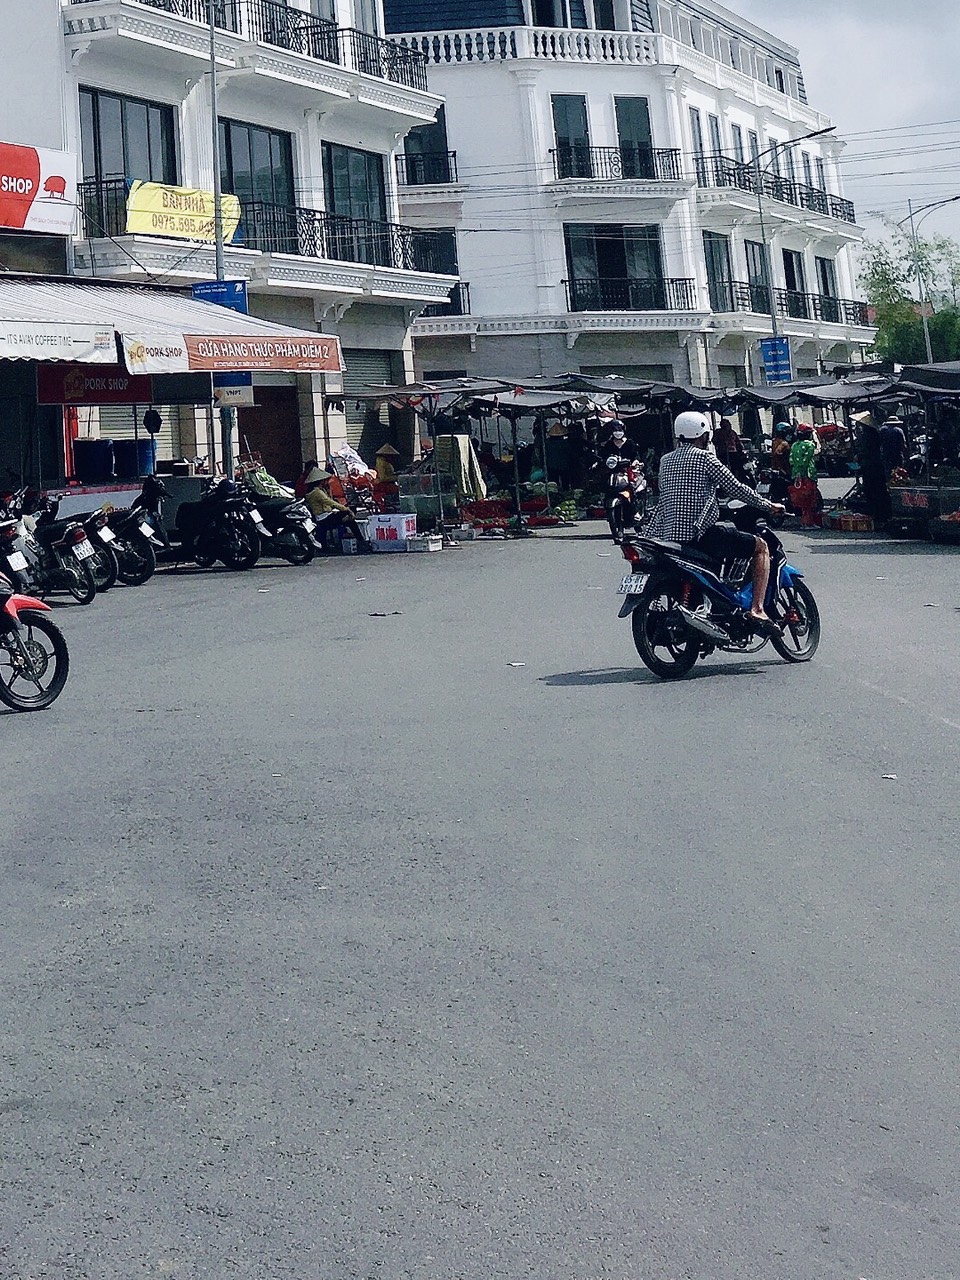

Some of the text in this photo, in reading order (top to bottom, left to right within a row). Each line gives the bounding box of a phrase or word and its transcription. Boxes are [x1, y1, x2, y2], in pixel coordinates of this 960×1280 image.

[1, 174, 34, 195] SHOP
[35, 335, 58, 346] COFFEE
[59, 335, 72, 347] TIME
[145, 347, 164, 357] PORK
[165, 347, 183, 357] SHOP
[198, 339, 221, 357] CỬA
[221, 340, 248, 357] HÀNG
[248, 341, 275, 361] THỰC
[322, 345, 330, 359] 2
[84, 377, 107, 390] PORK
[108, 377, 129, 390] SHOP
